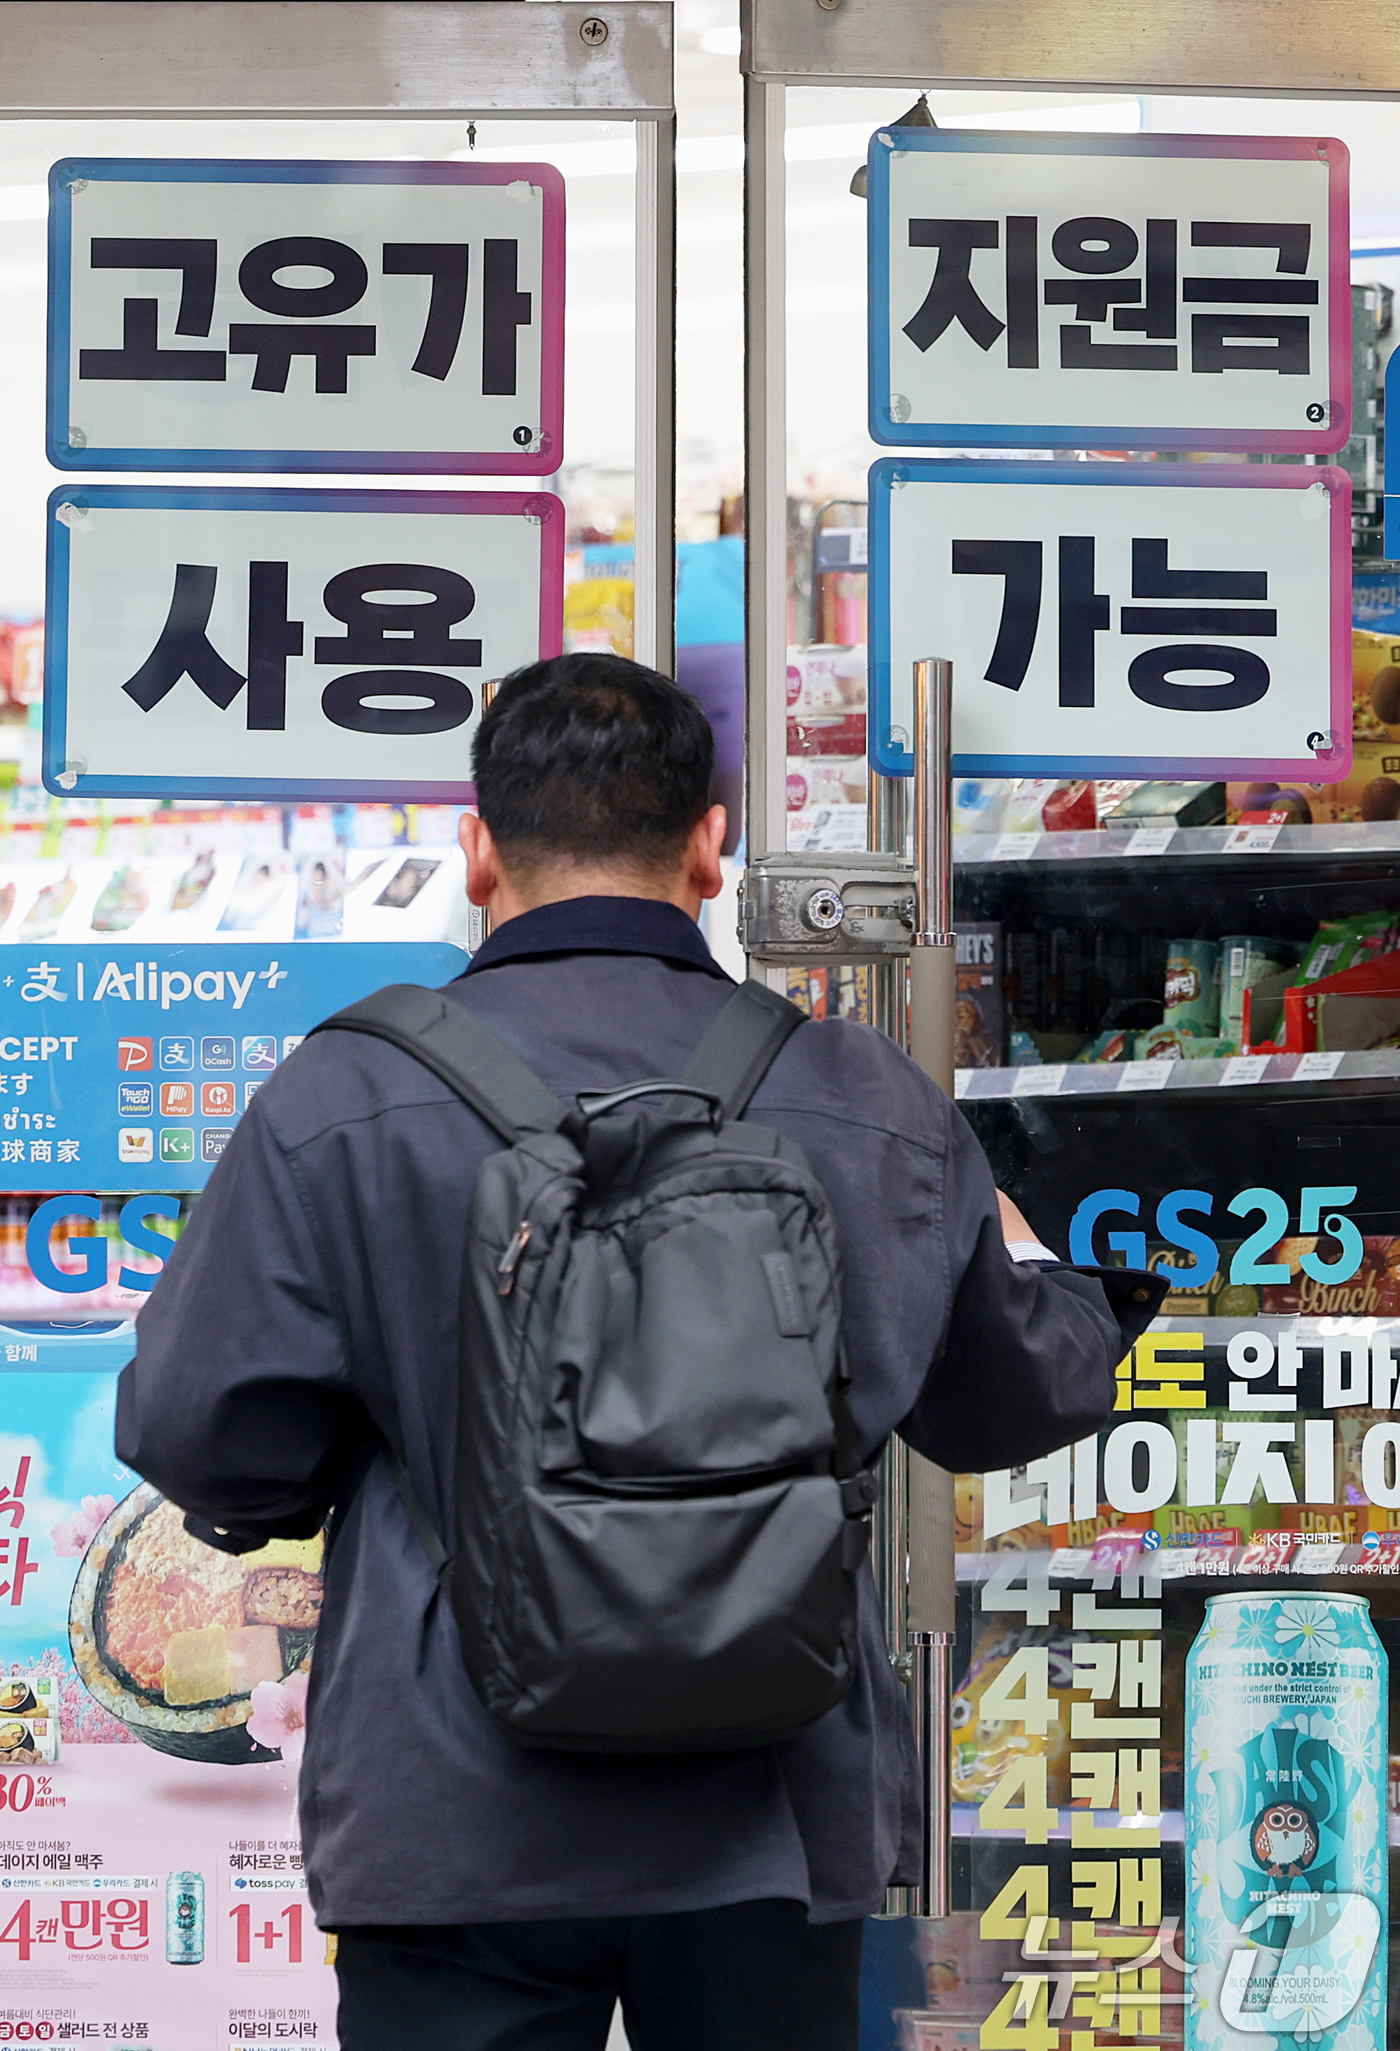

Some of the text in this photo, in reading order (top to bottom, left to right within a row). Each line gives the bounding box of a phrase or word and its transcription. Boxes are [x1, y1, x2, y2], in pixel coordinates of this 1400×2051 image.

[902, 215, 1320, 376] 지원금
[79, 236, 533, 396] 고유가
[951, 535, 1278, 713] 가능
[120, 560, 483, 735] 사용
[204, 1058, 232, 1066] GCash
[121, 1087, 150, 1097] Touch
[165, 1106, 188, 1114] MPay
[1068, 1185, 1364, 1289] GS25
[4, 1344, 38, 1362] 함께
[1226, 1331, 1303, 1412] 안
[1293, 1532, 1342, 1549] 국민카드
[1349, 1564, 1364, 1576] QR
[1291, 1660, 1338, 1678] NEST
[1340, 1664, 1374, 1681] BEER
[1249, 1683, 1273, 1693] under
[1274, 1683, 1288, 1692] the
[1290, 1682, 1313, 1693] strict
[1314, 1683, 1340, 1693] control
[1310, 1694, 1337, 1704] JAPAN
[26, 1840, 36, 1851] 안
[229, 1840, 266, 1852] 나들이를
[267, 1840, 278, 1851] 더
[42, 1853, 71, 1871] 에일
[74, 1853, 104, 1871] 맥주
[229, 1853, 288, 1871] 혜자로운
[13, 1879, 41, 1888] 신한카드
[102, 1879, 130, 1888] 우리카드
[133, 1878, 149, 1889] 결제
[149, 1878, 159, 1889] 시
[249, 1878, 274, 1889] toss
[274, 1878, 296, 1890] pay
[1265, 1902, 1303, 1914] NEST
[229, 1903, 303, 1964] 1+1
[85, 1953, 106, 1962] 500원
[107, 1953, 119, 1962] QR
[119, 1953, 149, 1962] 추가할인)
[1280, 1976, 1311, 1988] YOUR
[1313, 1976, 1341, 1988] DAISY
[35, 2008, 77, 2020] 식단관리!
[229, 2008, 310, 2020] 완벽한 나들이 한끼!
[57, 2022, 100, 2039] 샐러드
[102, 2022, 118, 2039] 전
[120, 2022, 150, 2039] 상품
[229, 2022, 318, 2039] 이달의 도시락
